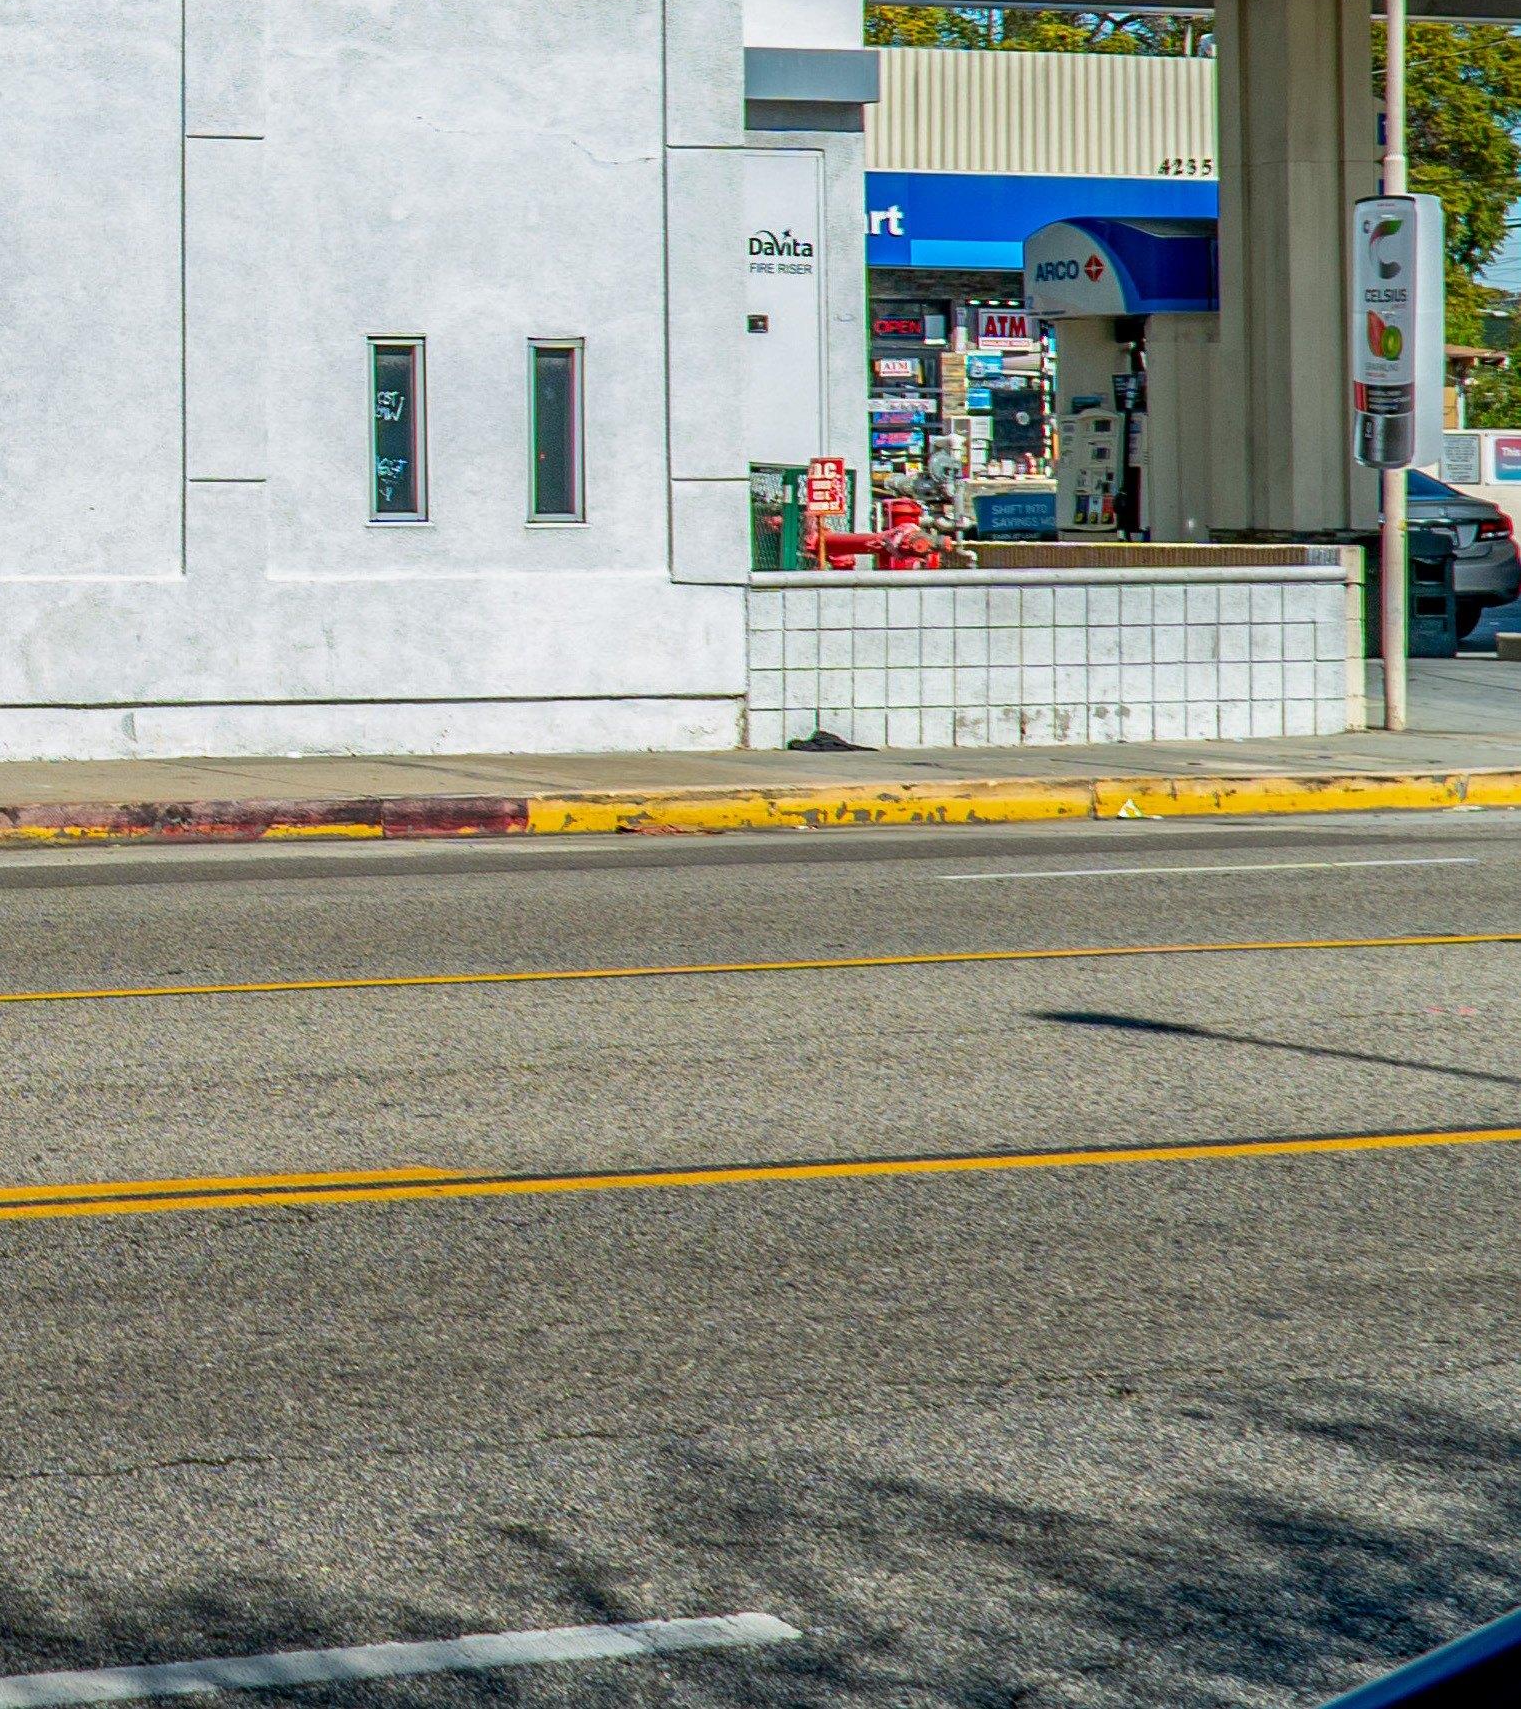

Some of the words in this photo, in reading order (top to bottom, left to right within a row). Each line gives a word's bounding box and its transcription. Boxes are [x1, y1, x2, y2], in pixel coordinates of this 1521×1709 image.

[1158, 157, 1212, 176] 4235
[865, 204, 905, 236] rt
[748, 230, 814, 258] DaVita
[749, 262, 775, 274] FIRE
[777, 262, 814, 275] RISER
[1036, 259, 1080, 282] ARCO
[1365, 288, 1407, 303] CELSIUS
[874, 318, 922, 335] OPEN
[984, 315, 1027, 338] ATM
[883, 361, 909, 372] ATM
[991, 504, 1023, 515] SHIFT
[1025, 503, 1047, 515] INTO
[991, 517, 1040, 529] SAVINGS
